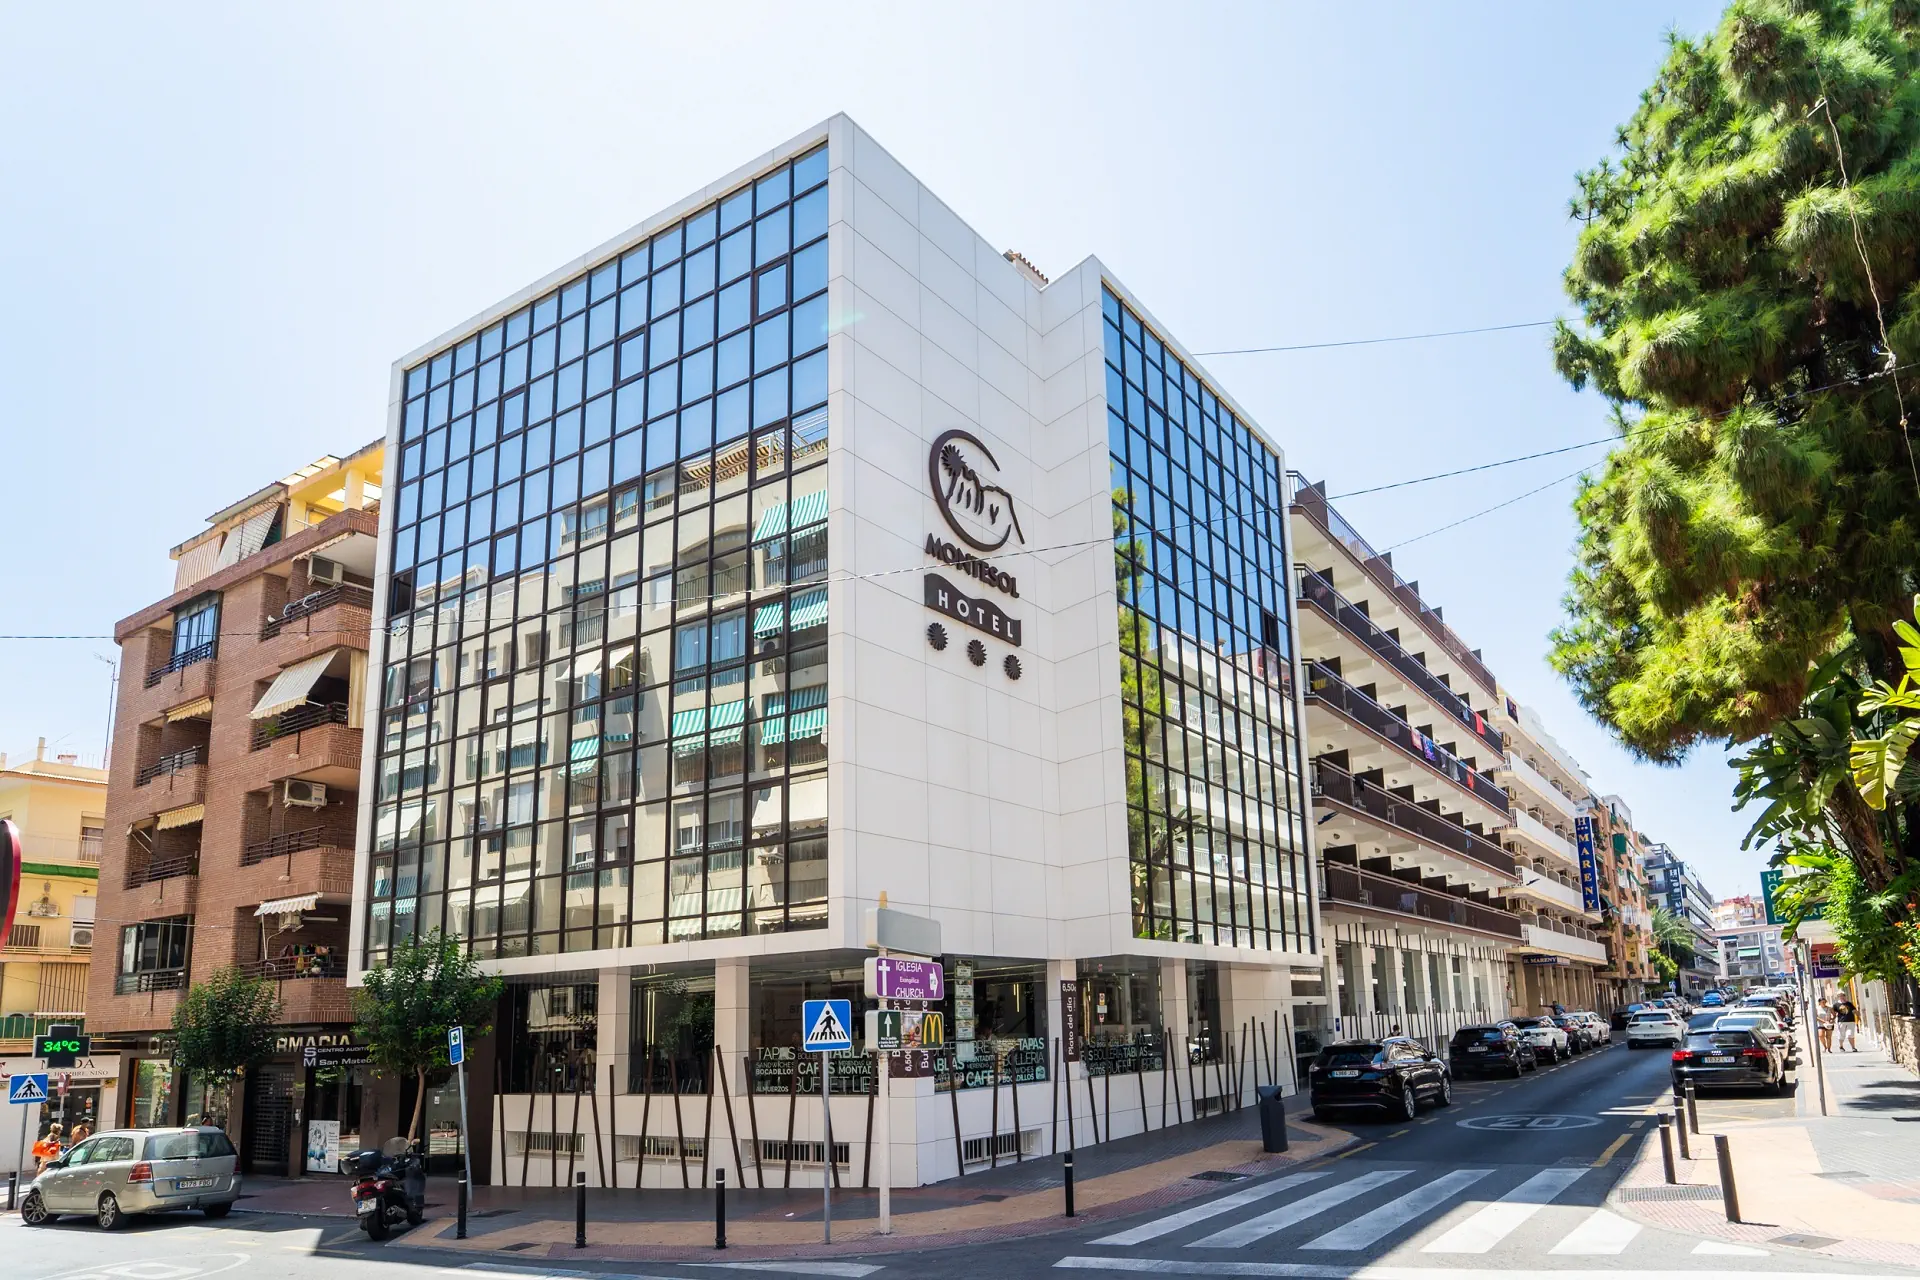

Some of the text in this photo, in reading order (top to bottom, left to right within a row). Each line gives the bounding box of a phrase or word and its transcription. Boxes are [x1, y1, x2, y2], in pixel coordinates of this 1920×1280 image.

[925, 532, 1020, 598] MONTESOL
[938, 588, 1014, 638] HOTEL
[1577, 833, 1595, 909] MARENY
[895, 961, 923, 973] IGLESIA
[895, 987, 925, 998] CHURCH
[1017, 1037, 1045, 1051] TAPAS
[1067, 1031, 1075, 1056] Plato
[755, 1046, 797, 1060] TAPS
[341, 1057, 372, 1065] Mateo
